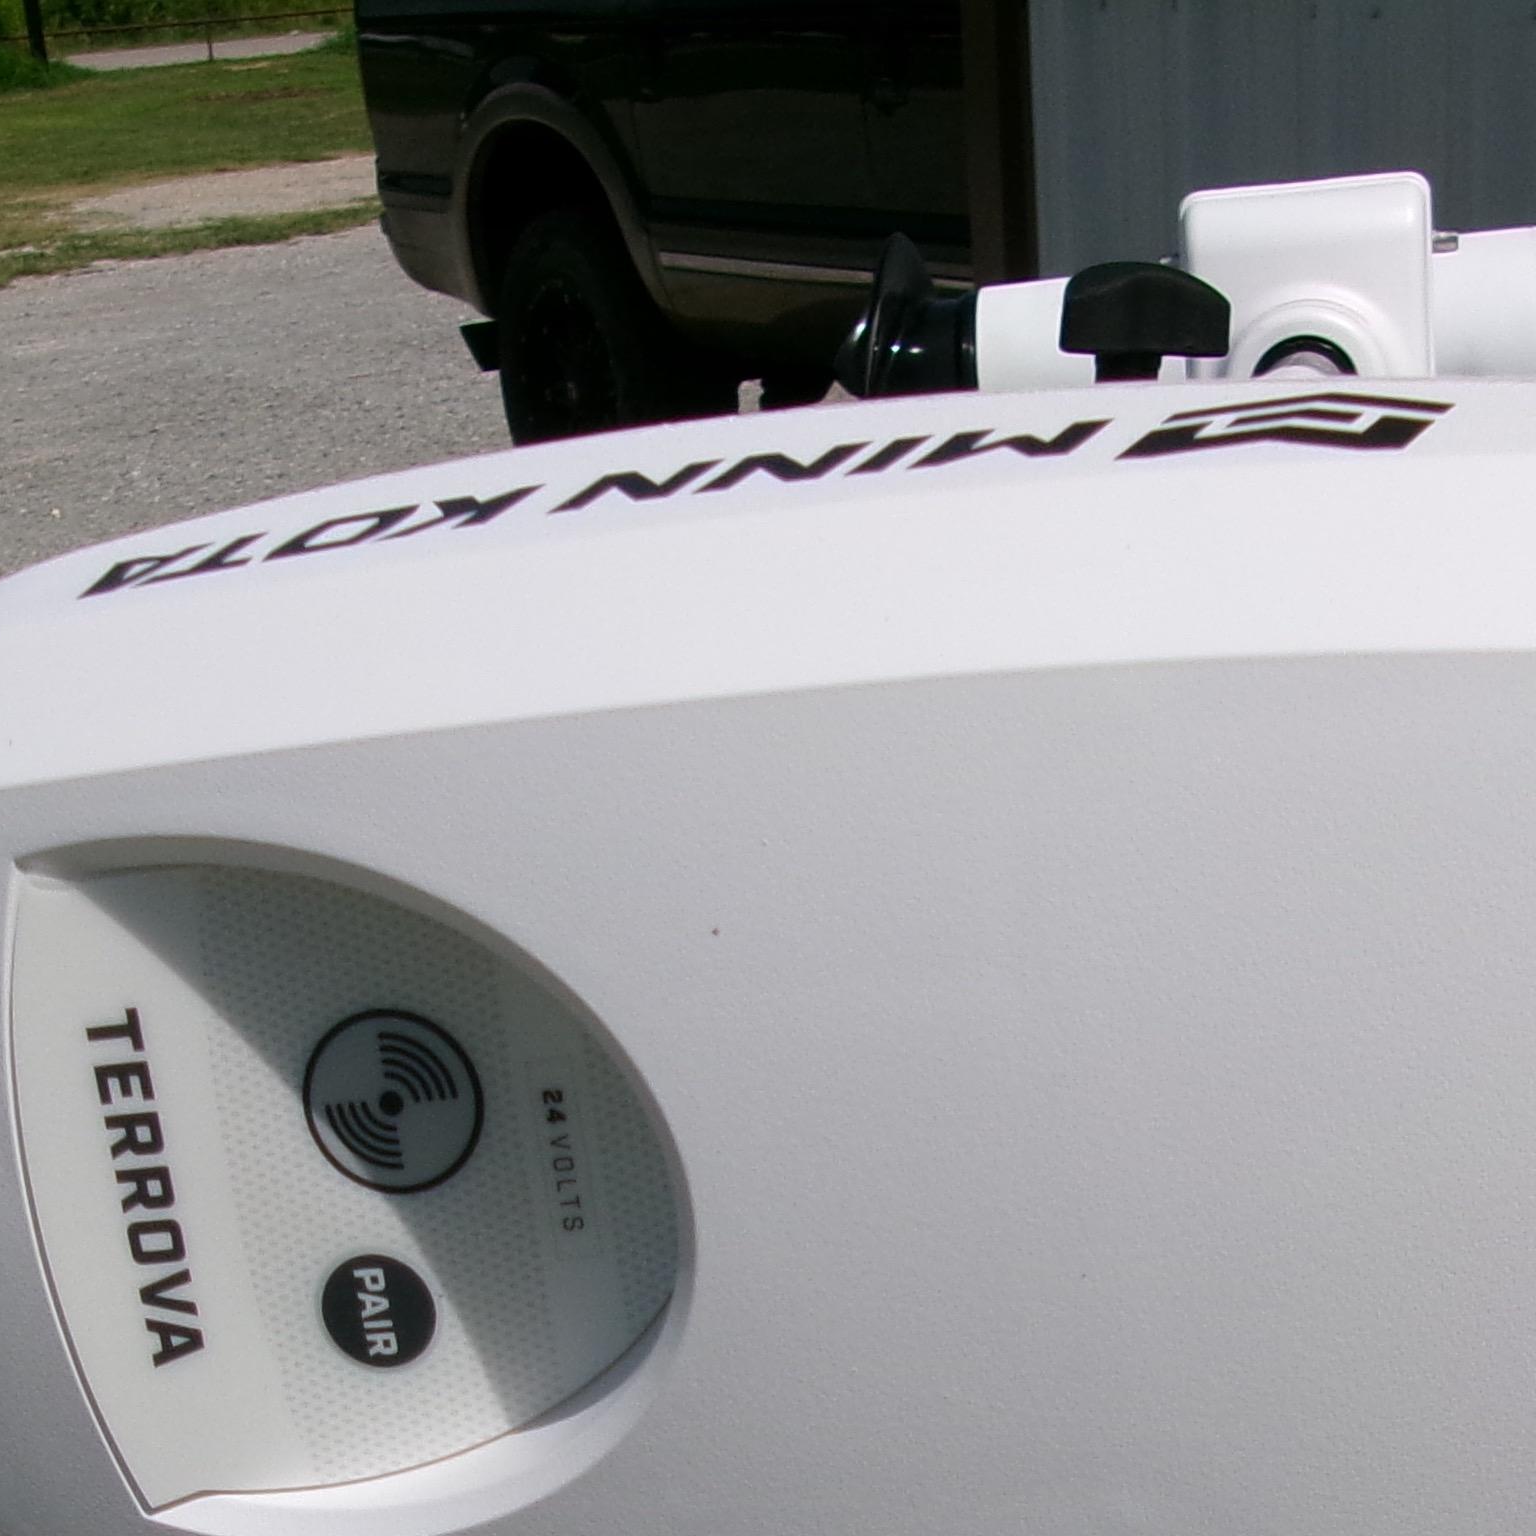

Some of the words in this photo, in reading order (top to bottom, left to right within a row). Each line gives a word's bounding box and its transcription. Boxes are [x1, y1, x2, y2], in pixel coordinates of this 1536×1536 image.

[549, 419, 1113, 514] MINN
[78, 485, 543, 598] KOTA
[540, 1088, 569, 1125] 24
[84, 1006, 205, 1369] TERROVA
[549, 1133, 585, 1233] VOLTS
[352, 1266, 399, 1358] PAIR
